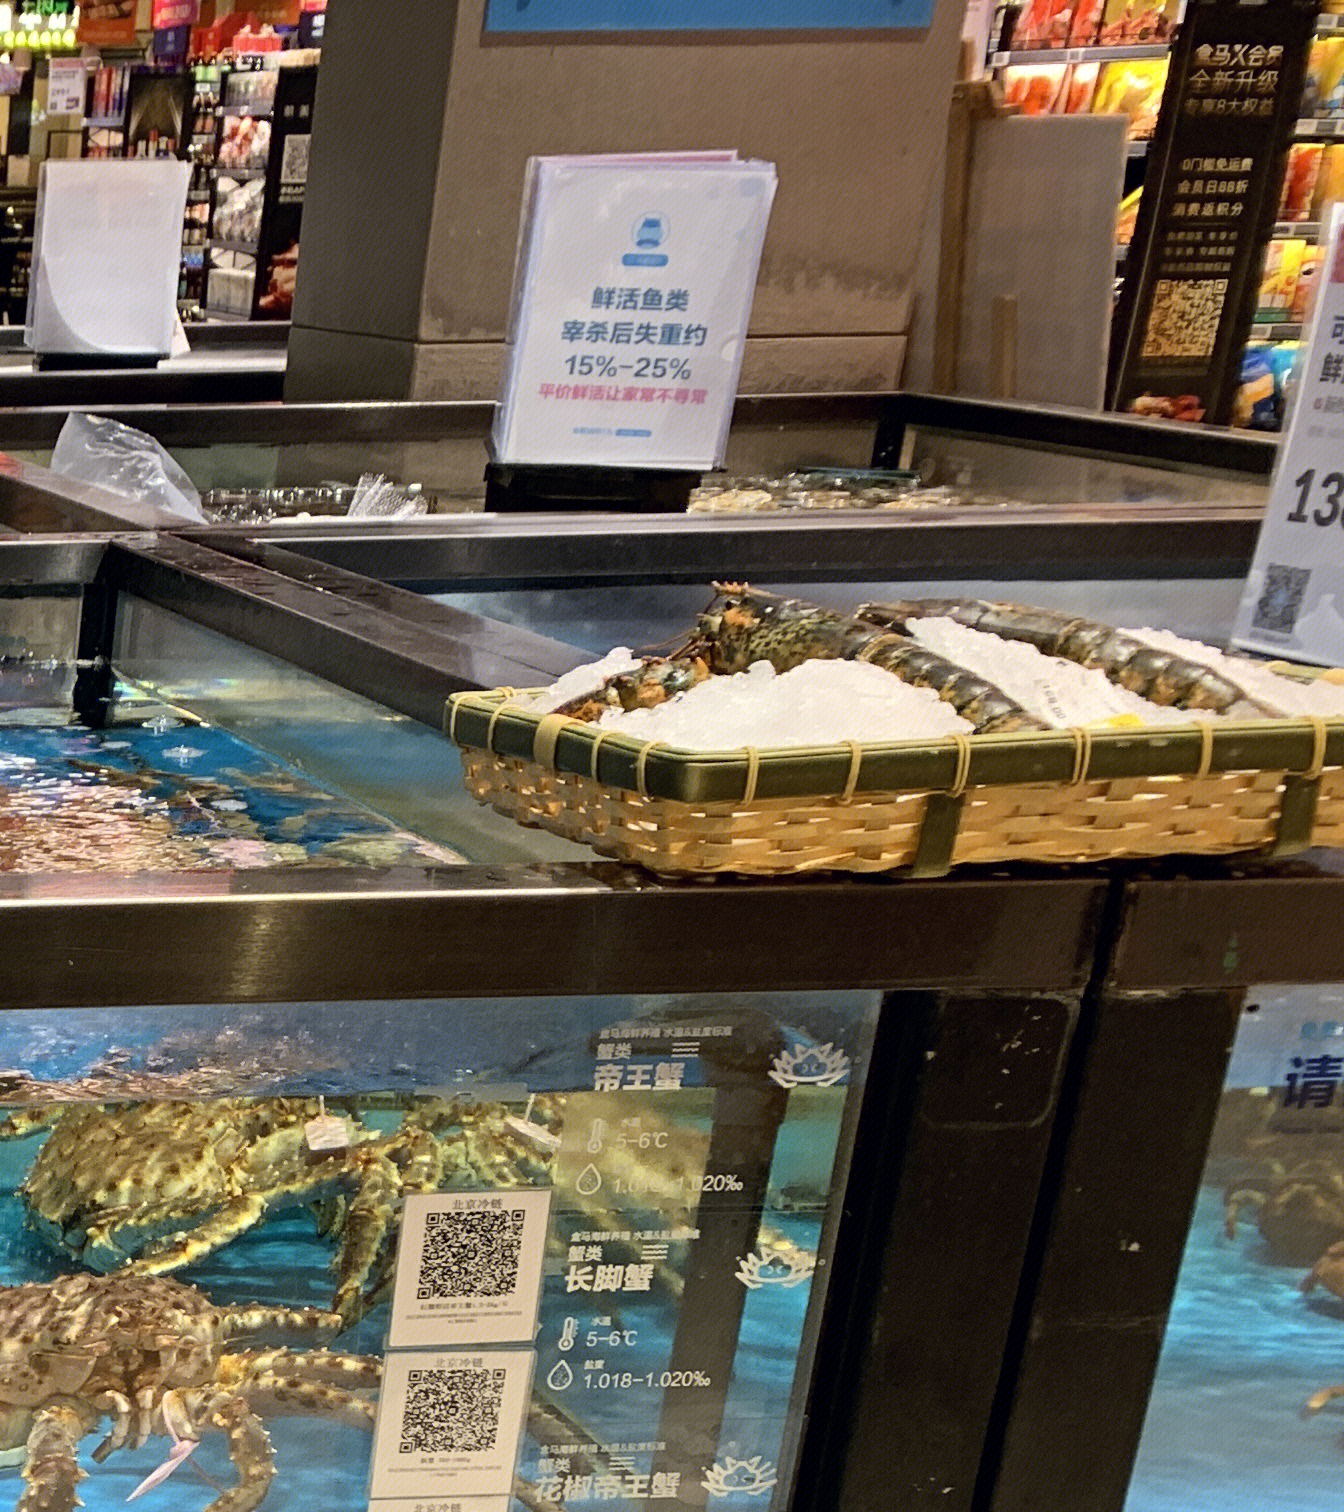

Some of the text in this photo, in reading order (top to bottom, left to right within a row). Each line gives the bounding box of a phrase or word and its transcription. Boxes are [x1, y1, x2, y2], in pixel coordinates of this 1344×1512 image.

[1190, 69, 1279, 95] 全新升级
[591, 286, 691, 312] 鲜活鱼类
[560, 320, 708, 347] 宰杀后失重约
[563, 354, 692, 380] 15%-25%
[596, 1042, 632, 1061] 蟹类
[593, 1061, 686, 1093] 帝王蟹
[567, 1245, 603, 1262] 蟹类
[564, 1263, 655, 1293] 长脚蟹
[590, 1316, 612, 1327] 水温
[583, 1371, 712, 1389] 1.018-1.020‰
[537, 1457, 572, 1474] 蟹类
